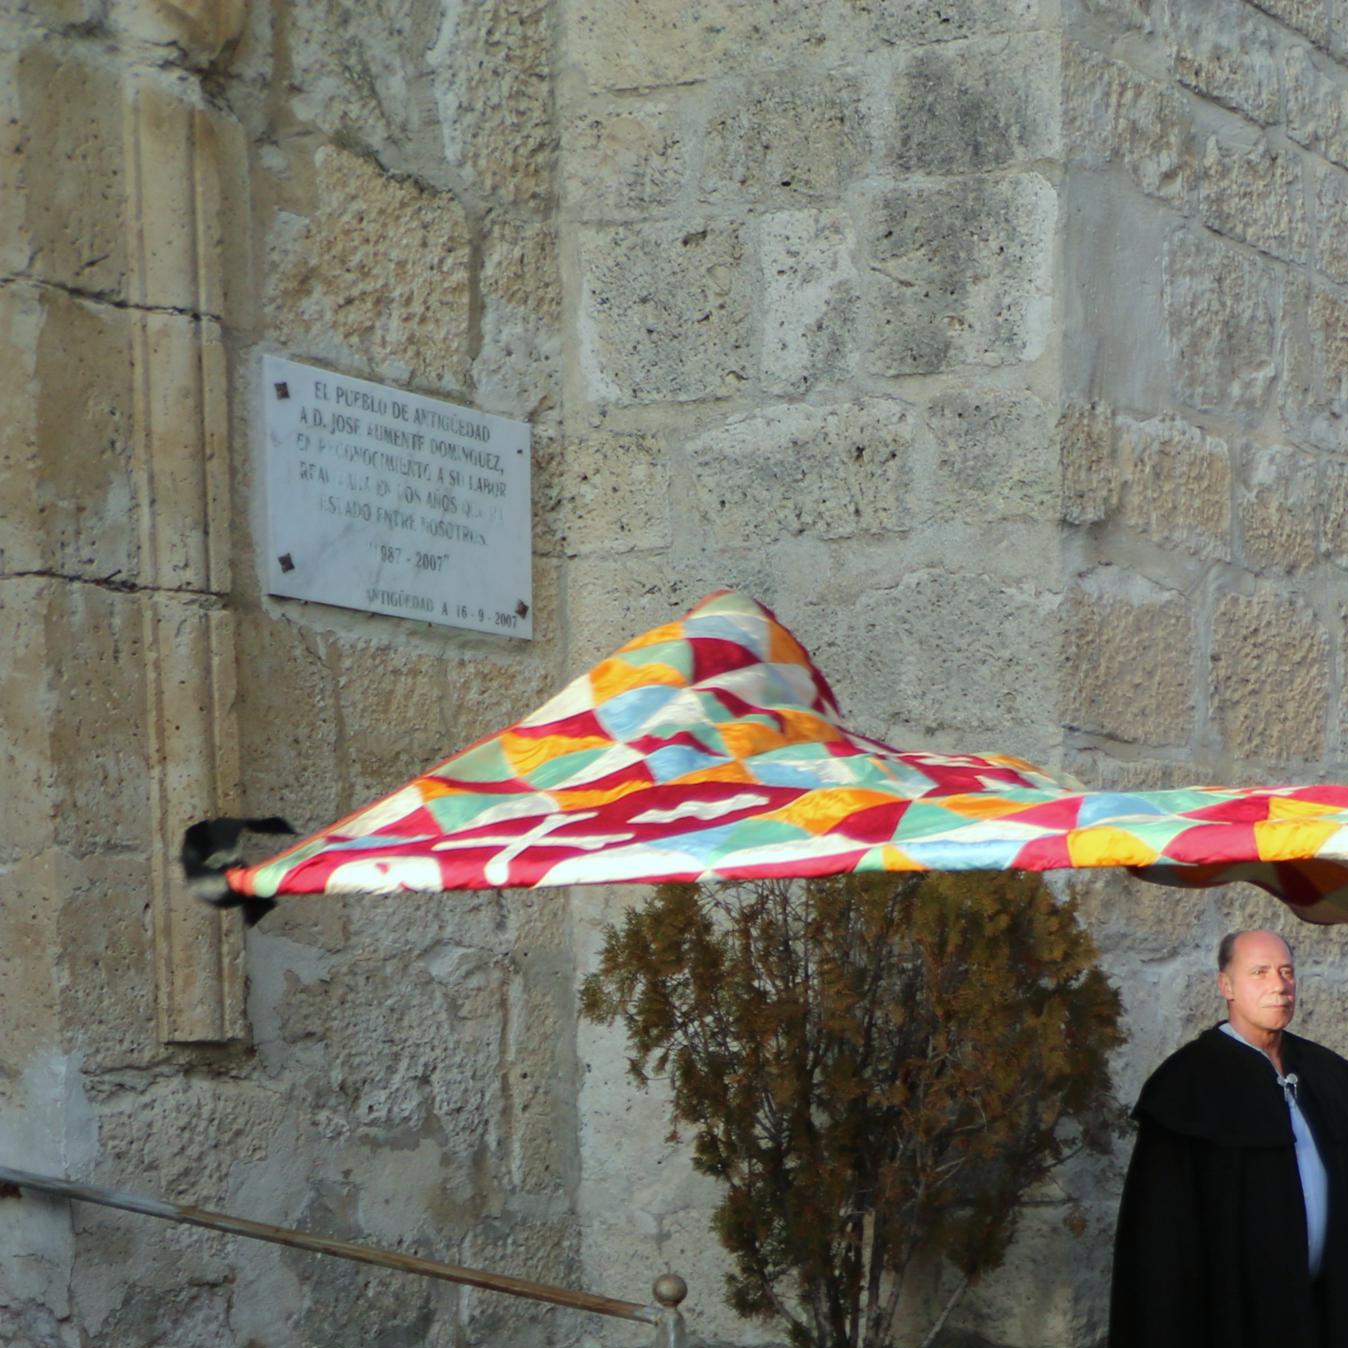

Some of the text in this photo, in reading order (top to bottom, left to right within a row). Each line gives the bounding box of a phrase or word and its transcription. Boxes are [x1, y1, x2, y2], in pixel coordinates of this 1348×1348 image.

[314, 381, 329, 400] EL
[336, 386, 387, 415] PUEBLO
[392, 400, 409, 422] DE
[300, 405, 308, 425] A
[438, 467, 445, 486] A
